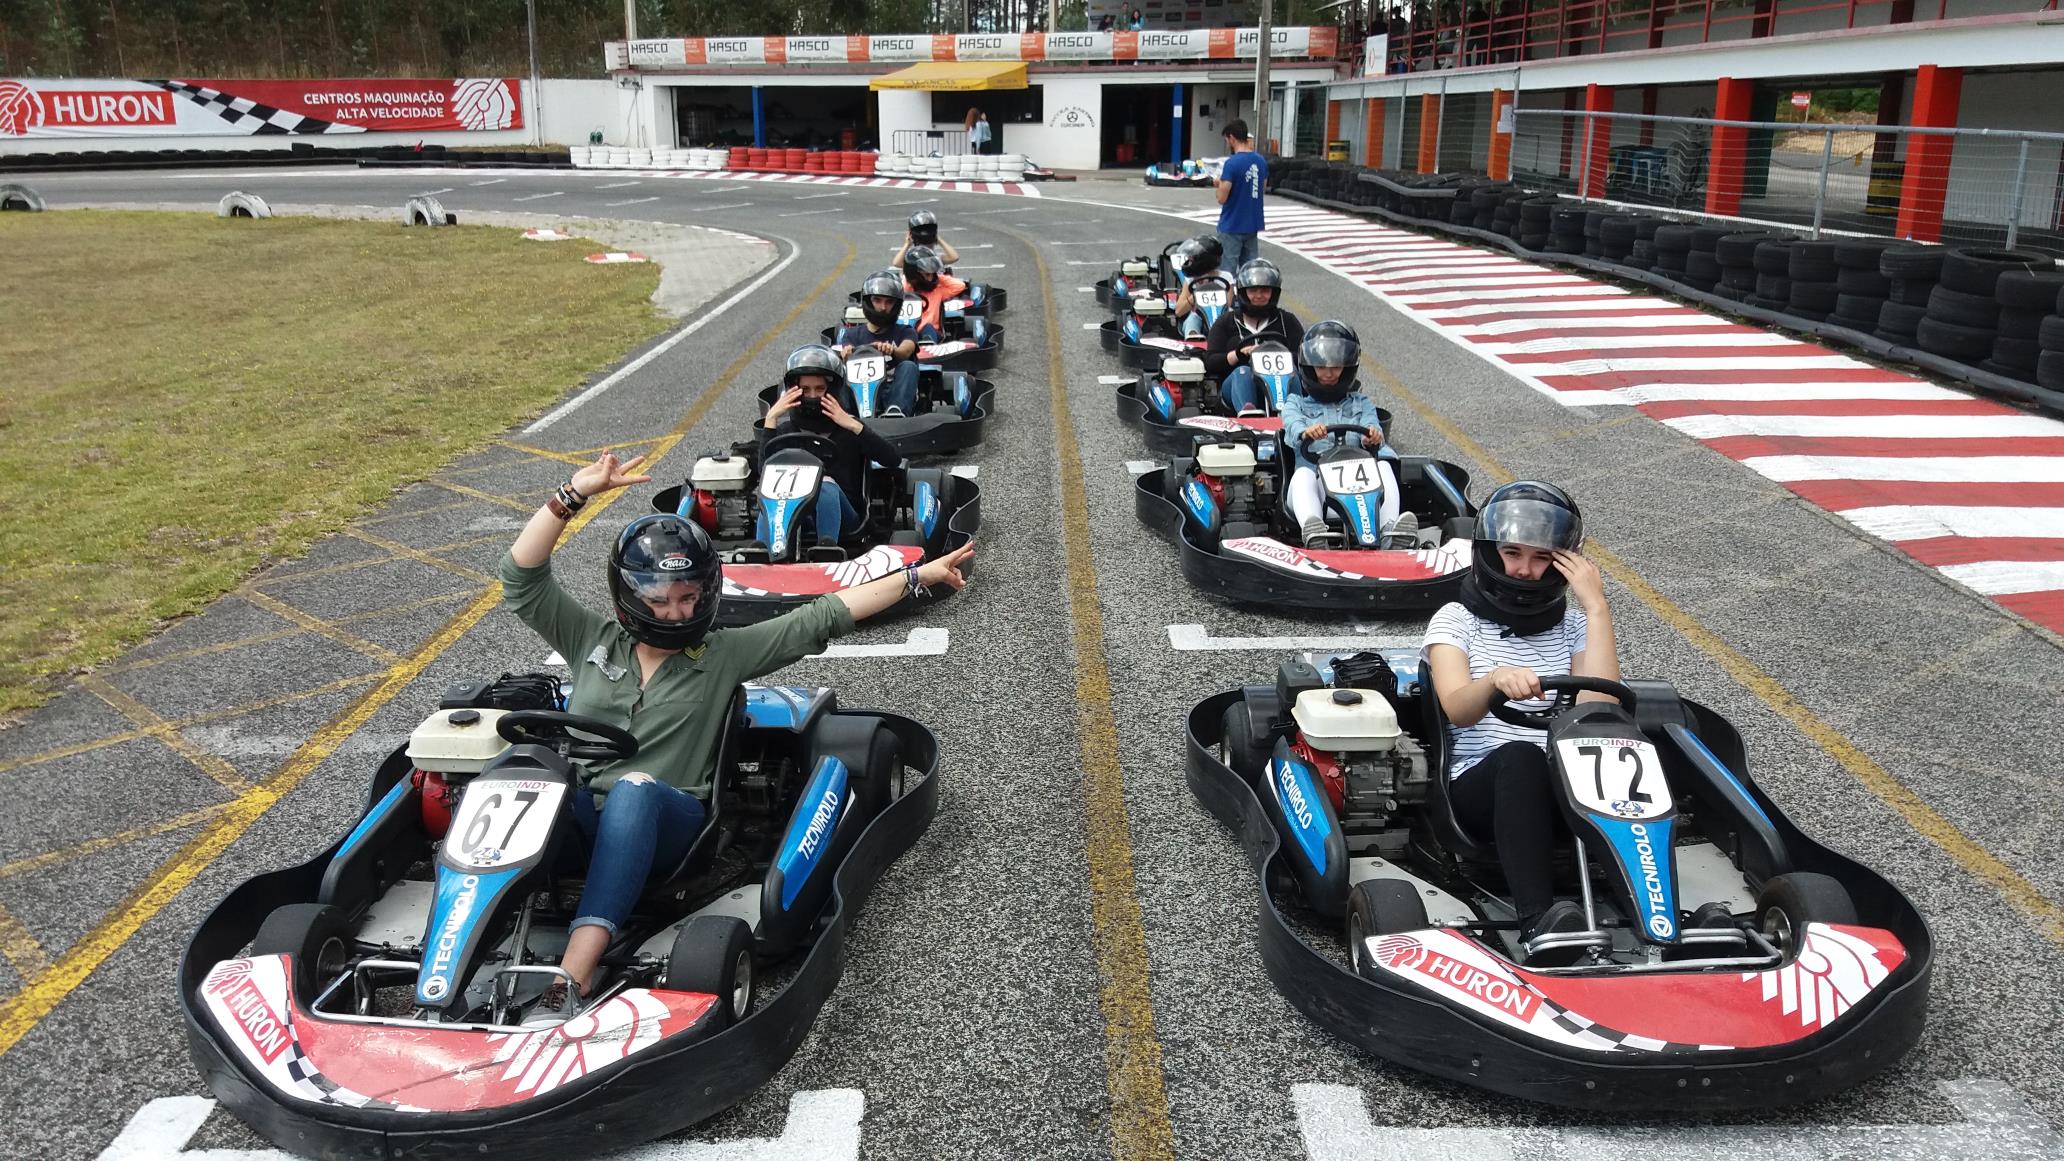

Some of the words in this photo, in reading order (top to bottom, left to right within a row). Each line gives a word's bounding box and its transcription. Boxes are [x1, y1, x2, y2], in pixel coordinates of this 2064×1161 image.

[790, 40, 829, 51] HASCO
[873, 39, 914, 50] HASCO
[958, 38, 1002, 49] HASCO
[1048, 36, 1093, 47] HASCO
[1142, 35, 1188, 46] HASCO
[1240, 32, 1288, 43] HACO
[631, 43, 669, 53] HASCO
[709, 41, 747, 52] HASCO
[304, 92, 361, 104] CENTROS
[364, 90, 445, 105] MAQUINAÇÃO
[53, 95, 165, 122] HURON
[336, 107, 368, 119] ALTA
[370, 107, 444, 118] VELOCIDADE
[1201, 292, 1218, 304] 64
[854, 360, 876, 379] 75
[1261, 354, 1285, 371] 66
[772, 468, 800, 493] 71
[1331, 463, 1370, 488] 74
[1249, 542, 1301, 564] HURON
[1572, 739, 1642, 749] EUROINDY
[1577, 745, 1653, 804] 72
[481, 781, 551, 790] EUROINDY
[1280, 761, 1312, 830] TECNIROLO
[462, 790, 540, 854] 67
[797, 790, 838, 860] TECNIROLO
[1631, 823, 1666, 914] TECNIROLO
[1428, 956, 1532, 1015] HURON
[230, 986, 287, 1056] HURON
